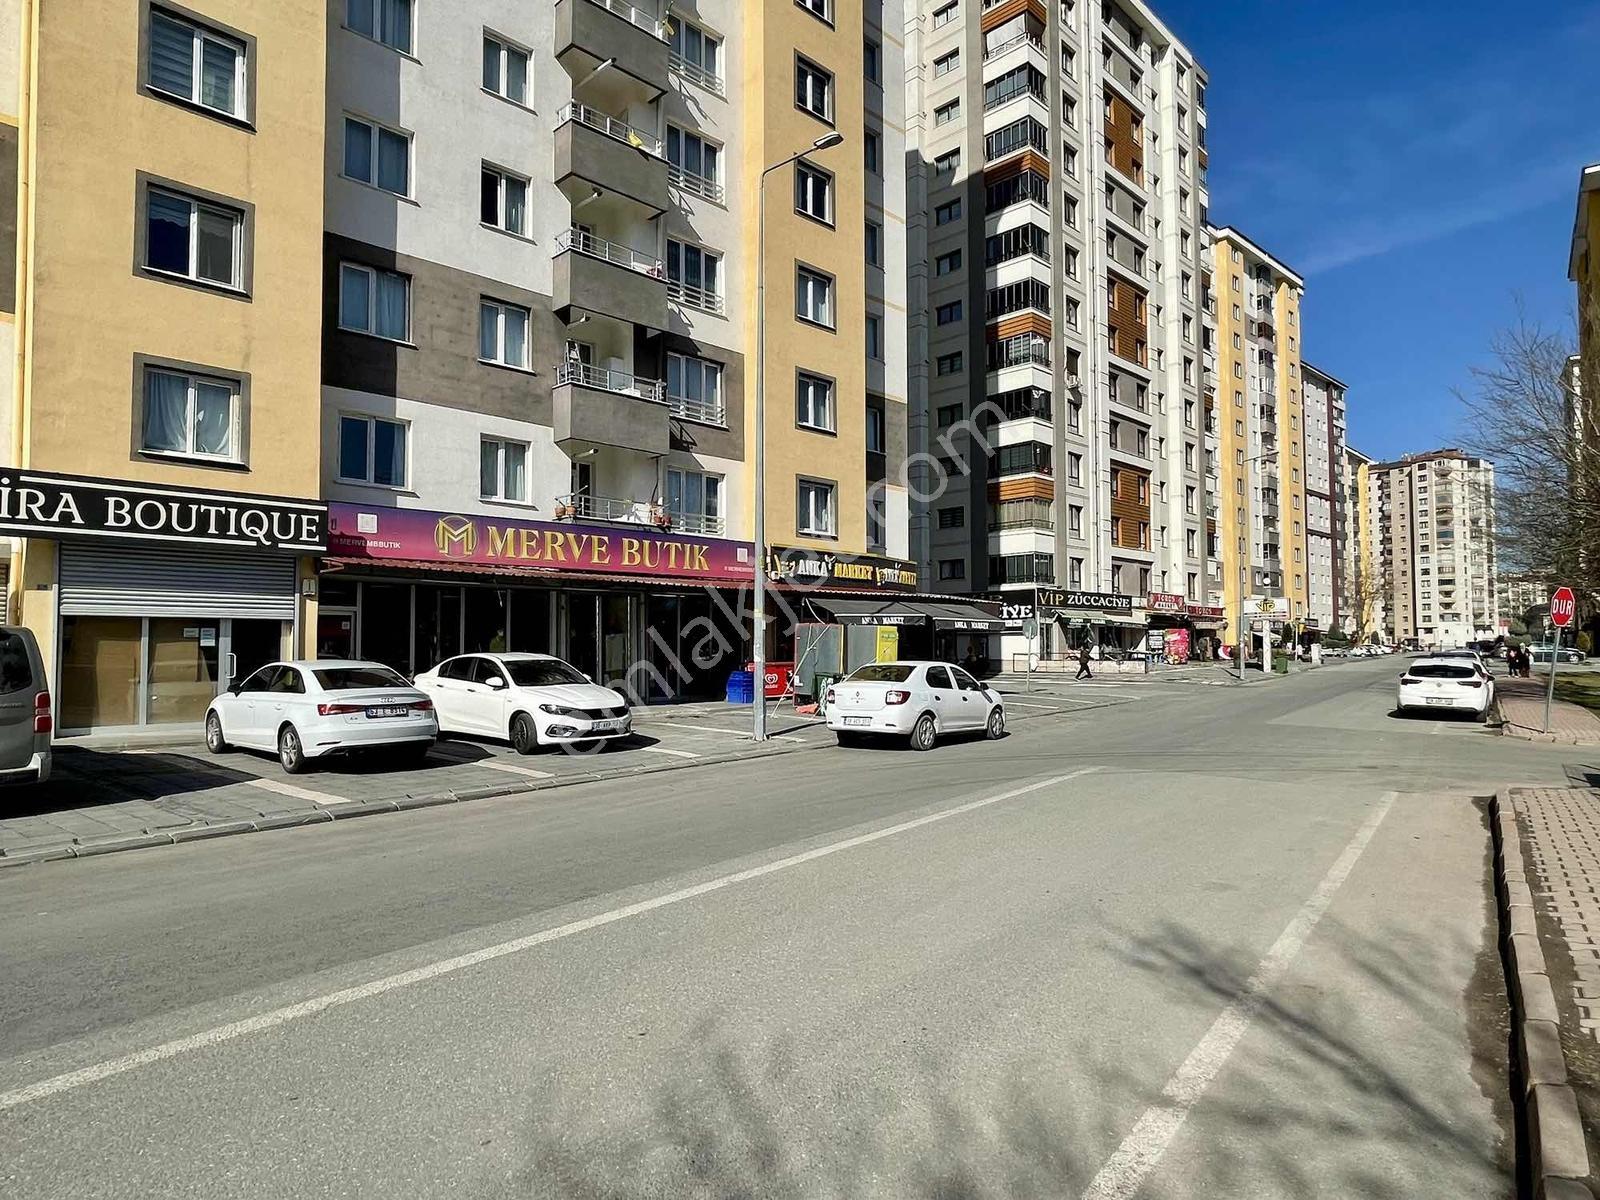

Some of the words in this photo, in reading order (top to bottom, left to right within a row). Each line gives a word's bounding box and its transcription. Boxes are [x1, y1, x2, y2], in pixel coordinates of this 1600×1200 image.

[104, 497, 320, 545] BOUTIQUE
[487, 526, 610, 565] MERVE
[622, 537, 710, 571] BUTIK
[797, 559, 828, 577] ANKA
[834, 563, 873, 580] MARKET
[1553, 599, 1573, 615] DUR
